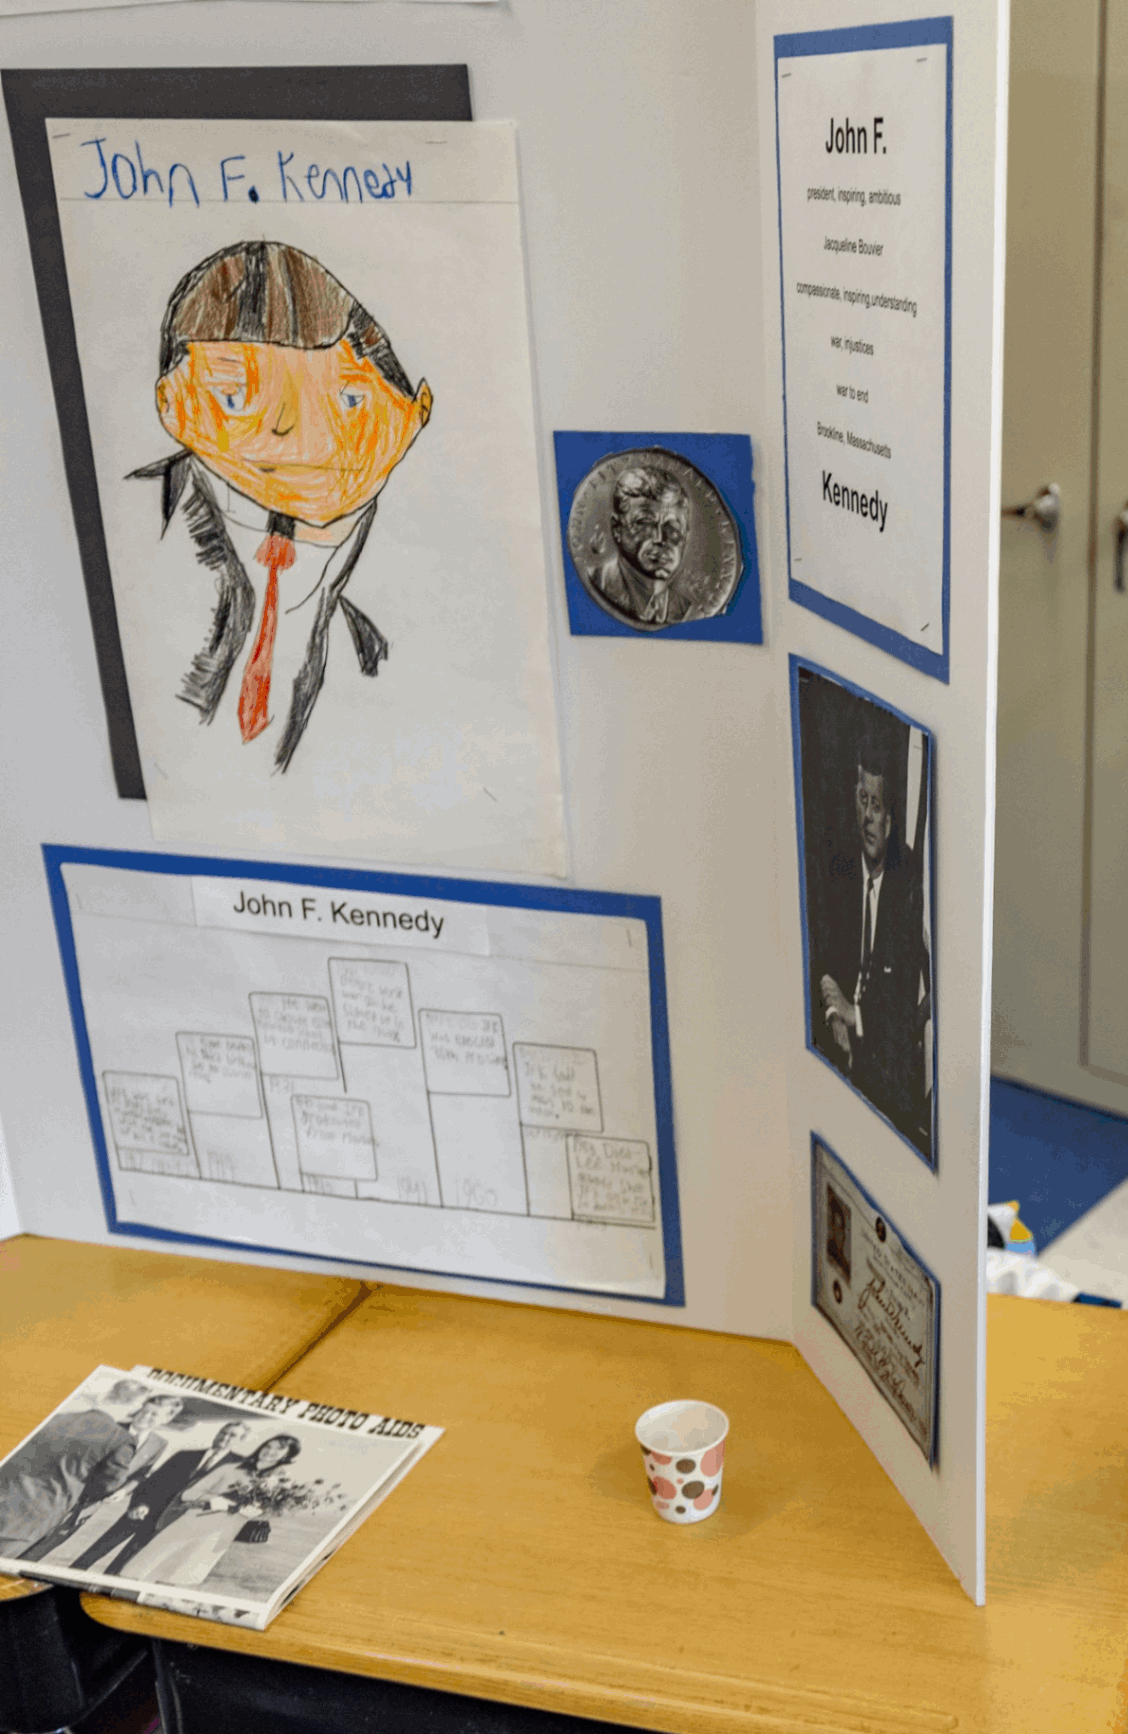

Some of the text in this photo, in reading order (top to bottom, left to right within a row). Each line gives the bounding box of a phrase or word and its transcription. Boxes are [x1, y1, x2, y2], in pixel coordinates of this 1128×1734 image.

[825, 116, 887, 153] John F.
[79, 138, 412, 209] John F. Kennedy
[807, 185, 901, 205] president, inspiring, ambitious
[823, 235, 884, 255] Jacqueline Bouvier
[796, 281, 842, 300] compassionate,
[844, 336, 874, 355] injustices
[836, 384, 869, 402] war to end
[817, 421, 892, 458] Brookline, Massachusetts
[821, 470, 888, 532] Kennedy
[233, 890, 445, 940] John F. Kennedy
[298, 1402, 370, 1430] PHOTO
[368, 1415, 426, 1439] AIDS
